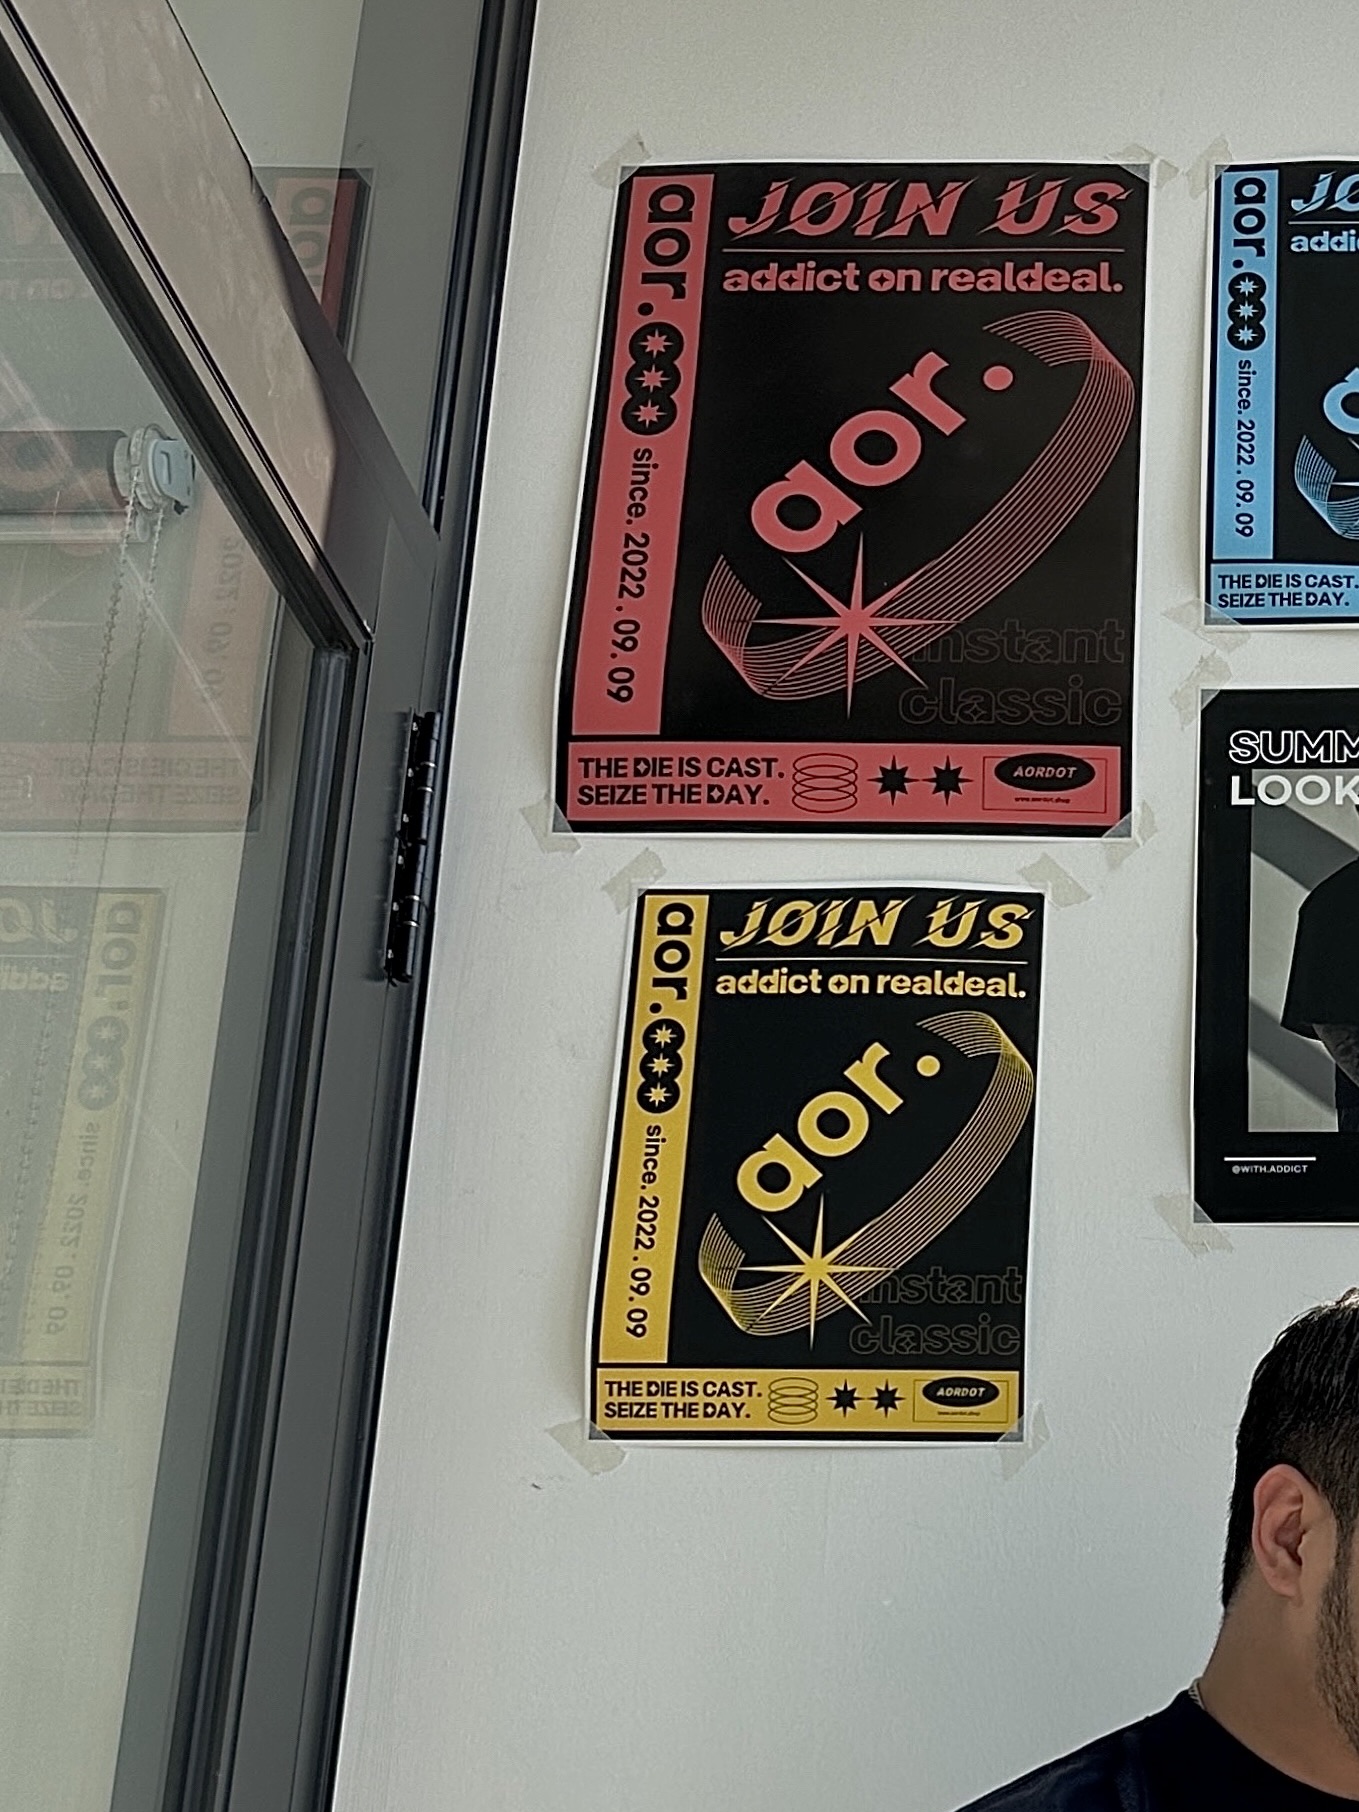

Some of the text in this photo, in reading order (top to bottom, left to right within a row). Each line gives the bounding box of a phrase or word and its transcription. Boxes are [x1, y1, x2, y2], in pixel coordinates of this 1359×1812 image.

[728, 174, 1133, 241] JOIN US
[723, 262, 1123, 293] addict on realdeal.
[1218, 574, 1359, 589] THE DIE IS CAST.
[1218, 592, 1349, 608] SEIZE THE DAY.
[912, 618, 1124, 664] nstant
[900, 674, 1122, 726] classic
[578, 757, 784, 778] THE DIE IS CAST.
[1013, 766, 1077, 778] AORDOT
[577, 784, 769, 805] SEIZE THE DAY.
[719, 895, 1035, 951] JOIN US
[715, 969, 1026, 998] addict on realdeal.
[860, 1267, 1022, 1304] nstant
[850, 1313, 1020, 1355] classic
[605, 1381, 762, 1397] THE DIE IS CAST.
[936, 1387, 985, 1397] AORDOT
[604, 1402, 750, 1418] SEIZE THE DAY.
